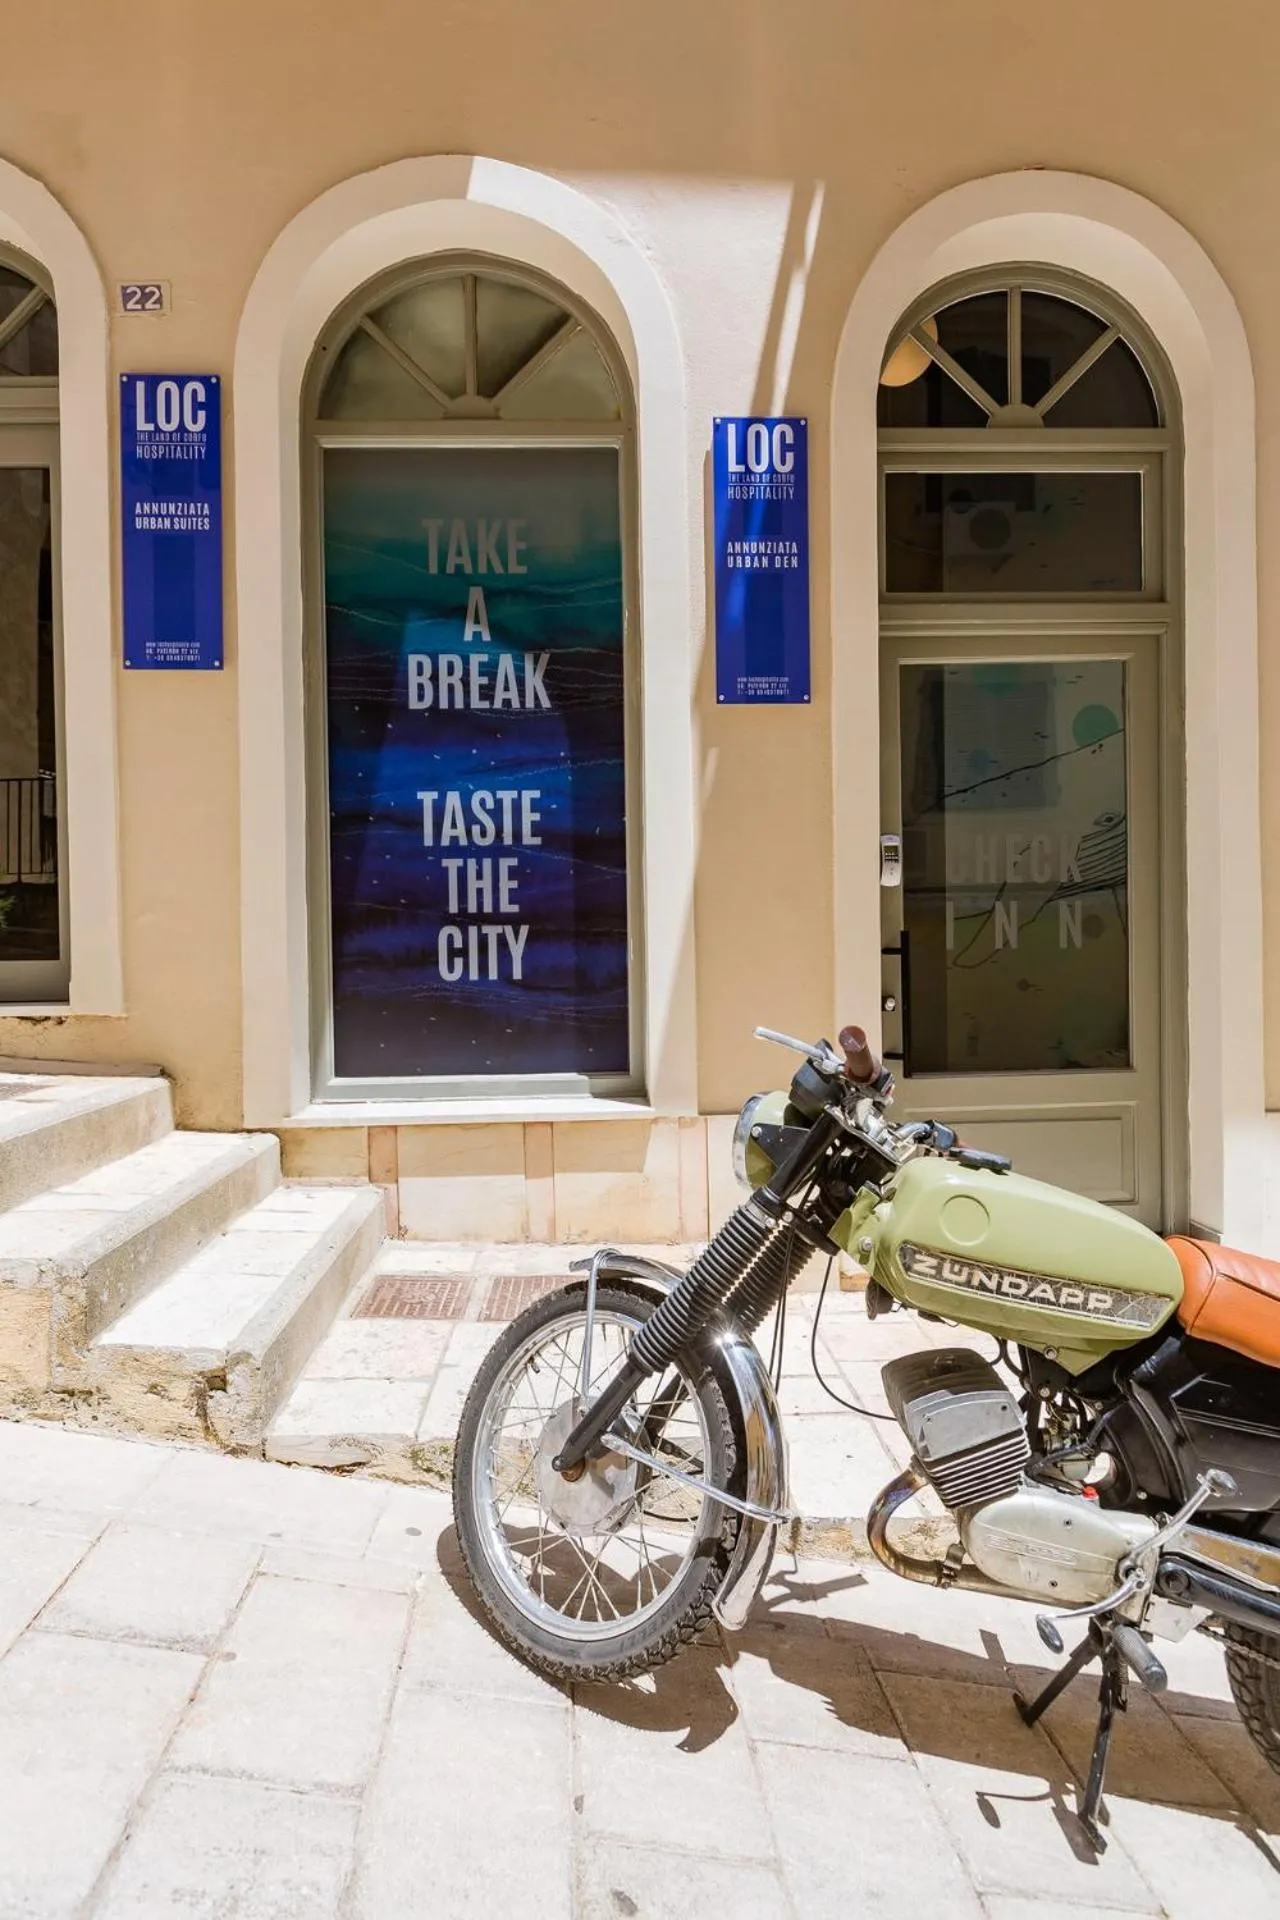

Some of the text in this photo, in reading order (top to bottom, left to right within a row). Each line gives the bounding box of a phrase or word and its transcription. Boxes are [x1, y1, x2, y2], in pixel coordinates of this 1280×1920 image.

[126, 286, 161, 310] 22
[136, 380, 206, 432] LOC
[136, 445, 206, 459] HOSPITALITY
[137, 432, 148, 441] THE
[151, 432, 170, 442] LAND
[173, 432, 180, 442] OF
[727, 423, 794, 473] LOC
[135, 502, 210, 515] ANNUNZIATA
[727, 486, 795, 500] HOSPITALITY
[135, 516, 210, 530] URBAN SUITES
[421, 518, 528, 574] TAKE
[727, 542, 798, 554] ANNUNZIATA
[727, 556, 799, 568] URBAN DEN
[463, 586, 492, 641] A
[407, 653, 552, 709] BREAK
[417, 790, 542, 846] TASTE
[946, 834, 1082, 883] CHECK
[441, 857, 520, 913] THE
[437, 925, 530, 981] CITY
[912, 1253, 1115, 1310] ZÜNDAPP
